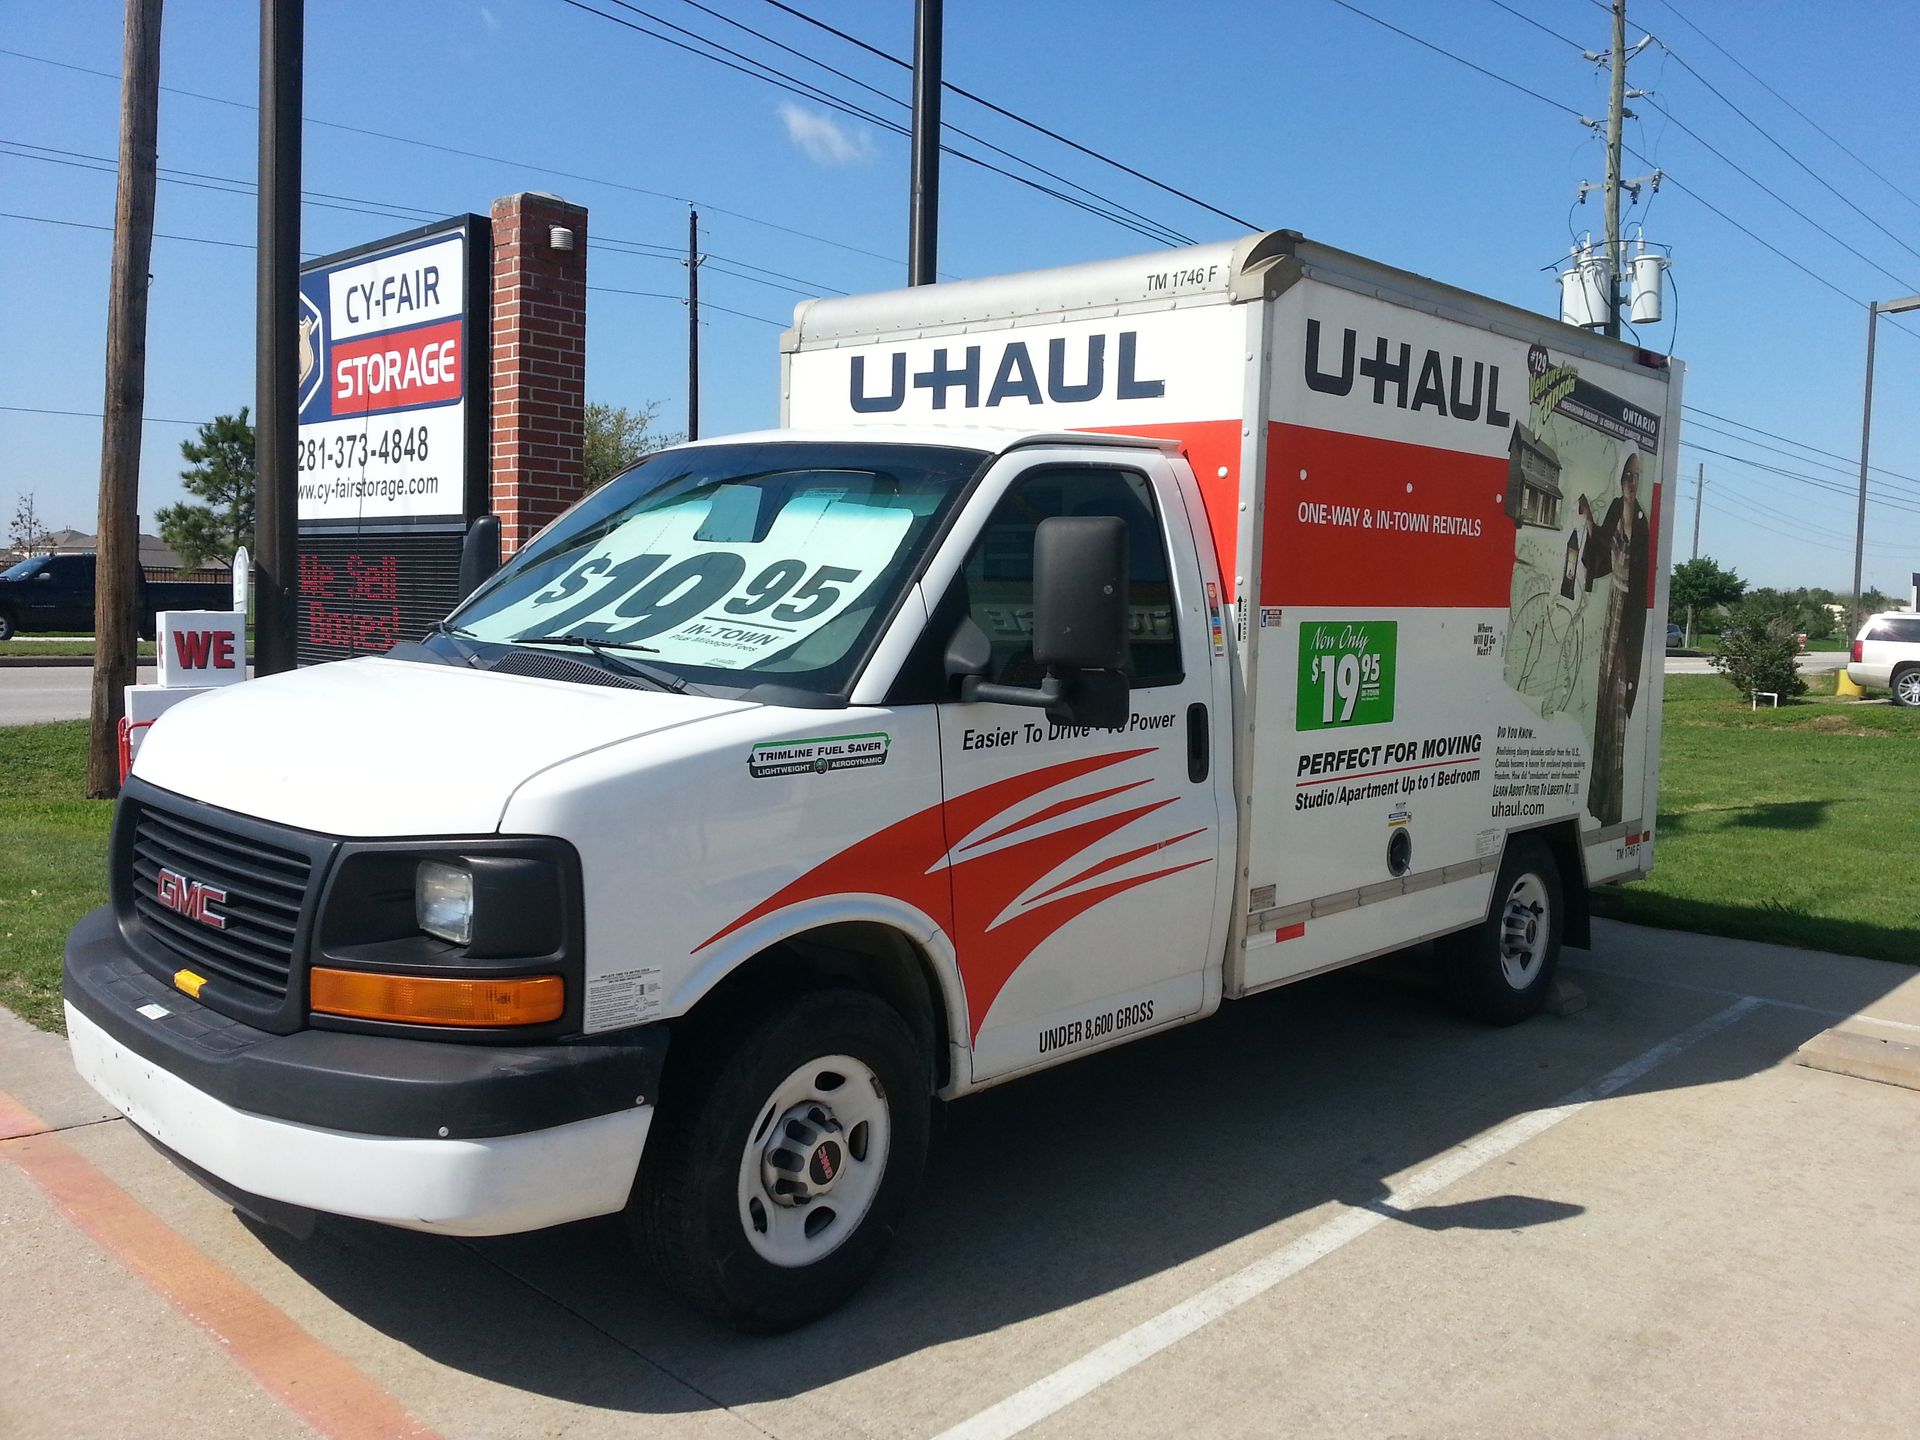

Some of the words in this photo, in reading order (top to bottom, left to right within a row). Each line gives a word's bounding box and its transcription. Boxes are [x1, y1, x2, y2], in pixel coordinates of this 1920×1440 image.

[346, 266, 440, 323] CY-FAIR
[1147, 273, 1167, 291] TM
[1172, 268, 1204, 287] 1746
[1208, 265, 1218, 282] F
[337, 340, 455, 399] STORAGE
[850, 331, 1165, 413] U-HAUL
[1304, 319, 1510, 427] U-HAUL
[1531, 351, 1547, 374] #129
[1623, 407, 1656, 434] ONTARIO
[298, 426, 428, 471] 281-373-4848
[1298, 502, 1360, 527] ONE-WAY
[1363, 509, 1373, 529] &
[1377, 510, 1429, 533] IN-TOWN
[1432, 515, 1482, 537] RENTALS
[300, 555, 335, 596] We
[347, 555, 397, 599] Sell
[173, 631, 236, 669] WE
[681, 623, 779, 646] IN-TOWN
[1310, 626, 1335, 650] Now
[1339, 624, 1369, 658] Only
[962, 727, 1018, 751] Easier
[1024, 723, 1043, 744] To
[1048, 723, 1090, 741] Drive
[1130, 713, 1176, 732] Power
[757, 764, 811, 776] LIGHTWEIGHT
[831, 757, 883, 768] AERODYNAMIC
[758, 748, 813, 762] TRIMLINE
[817, 746, 845, 756] FUEL
[847, 742, 882, 753] SAVER
[1297, 746, 1381, 777] PERFECT
[1383, 741, 1418, 764] FOR
[1421, 733, 1482, 760] MOVING
[1295, 779, 1399, 811] Studio/Apartment
[1401, 776, 1416, 795] Up
[1418, 774, 1429, 790] to
[1430, 773, 1435, 788] 1
[1437, 769, 1480, 787] Bedroom
[1491, 800, 1545, 817] uhaul.com
[1616, 848, 1625, 861] TM
[157, 867, 227, 929] GMC
[1039, 1021, 1082, 1053] UNDER
[1085, 1012, 1113, 1040] 8,600
[1116, 1000, 1154, 1030] GROSS
